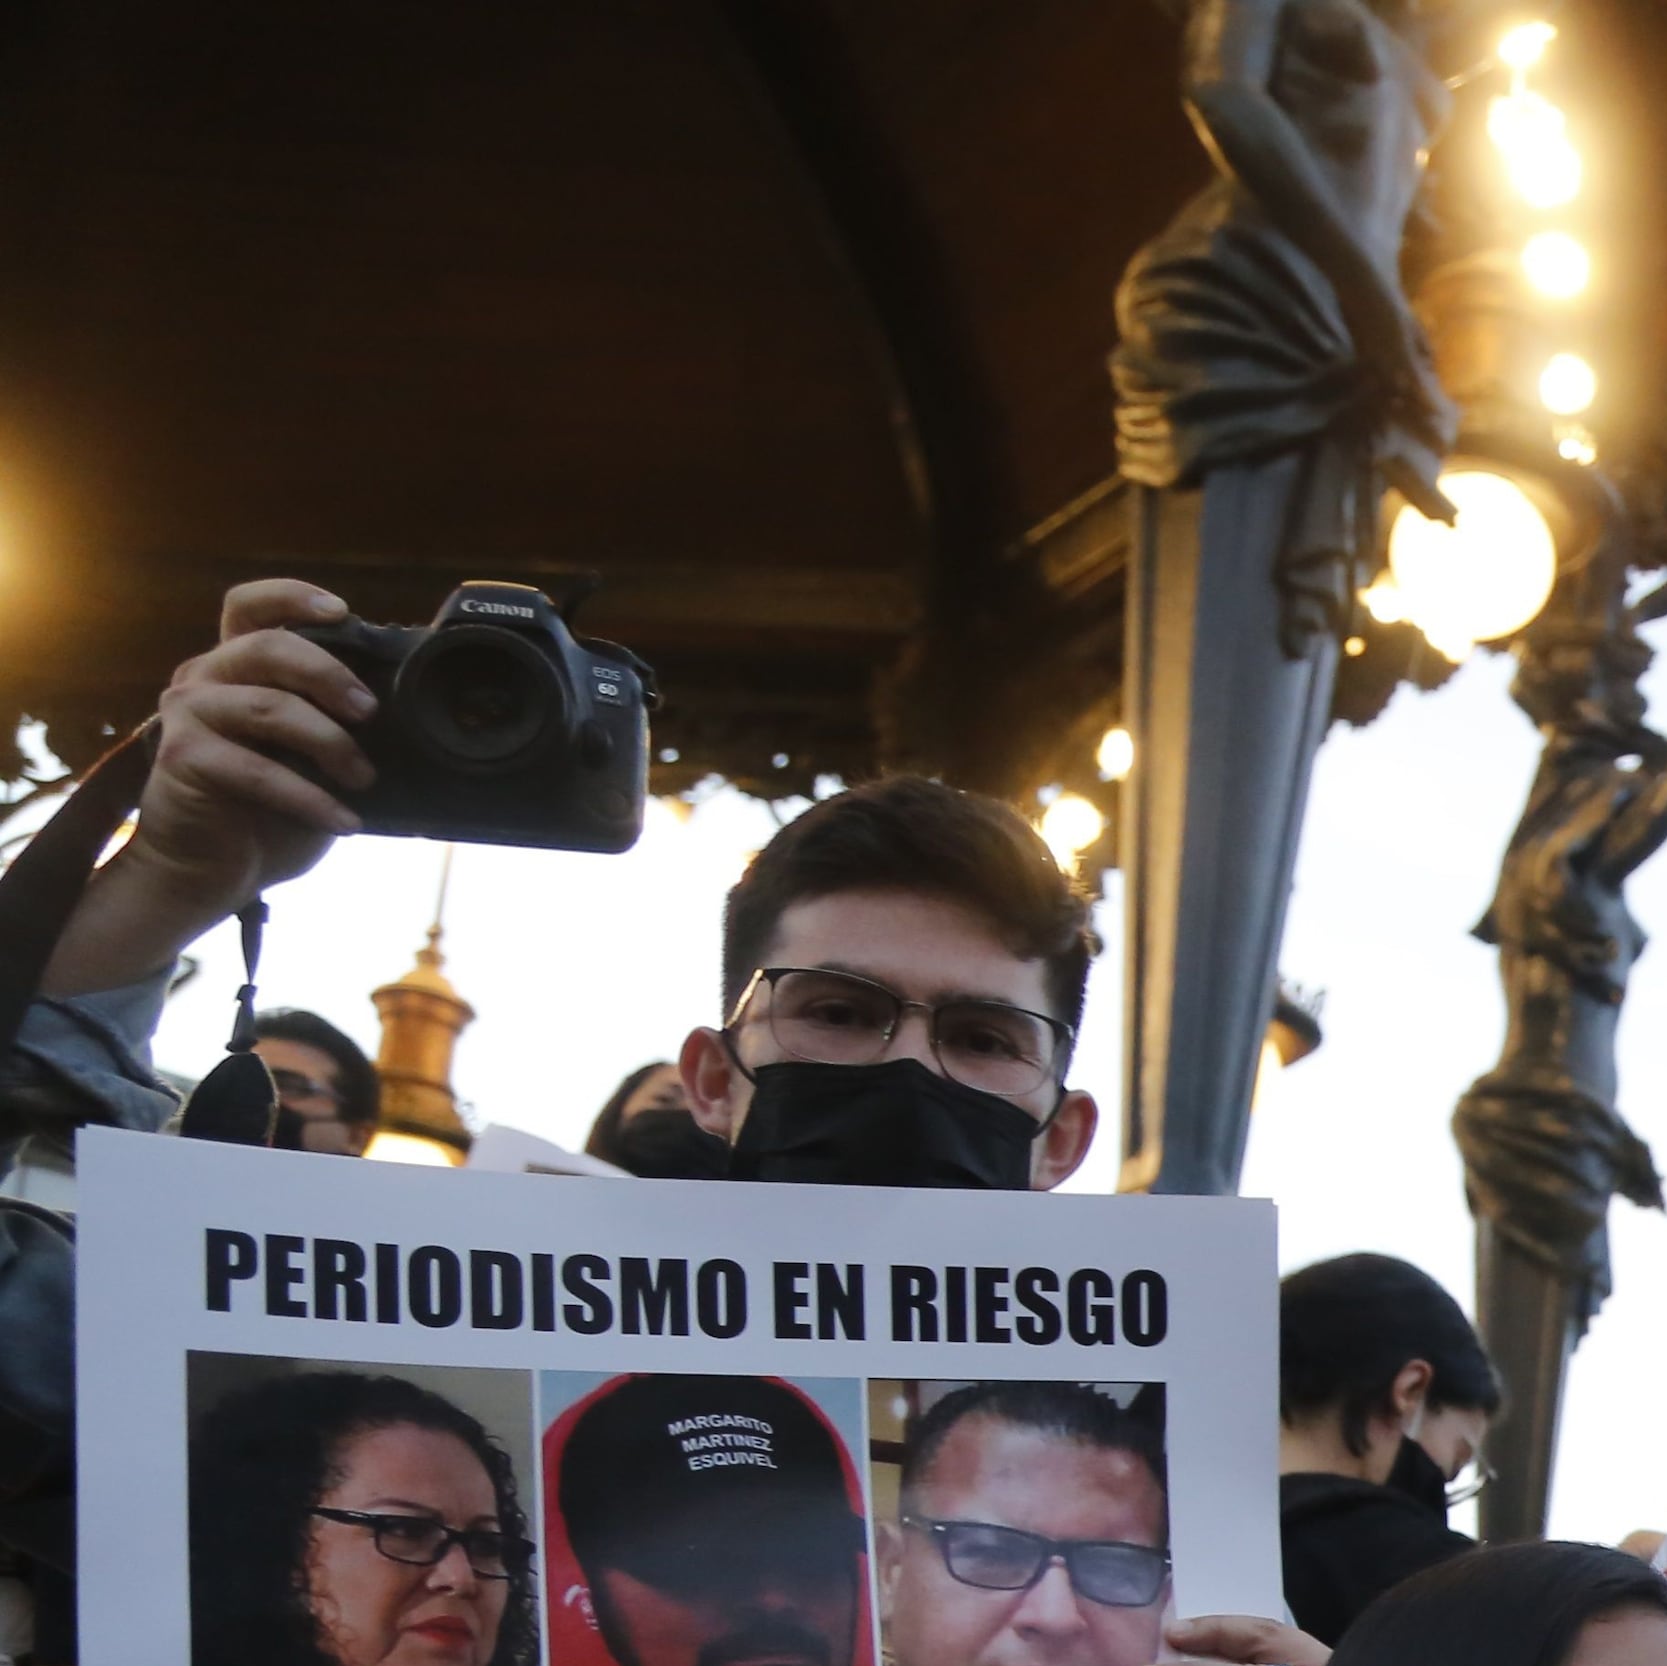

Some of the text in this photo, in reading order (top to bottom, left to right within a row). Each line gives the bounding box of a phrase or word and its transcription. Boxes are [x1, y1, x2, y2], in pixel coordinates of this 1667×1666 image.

[461, 599, 534, 619] Canon
[592, 666, 621, 681] EOS
[598, 683, 618, 696] 6D
[204, 1228, 1169, 1349] PERIODISMO EN RIESGO
[667, 1414, 773, 1436] MARGARITO
[682, 1433, 774, 1453] MARTINEZ
[688, 1451, 778, 1471] ESQUIVEL
